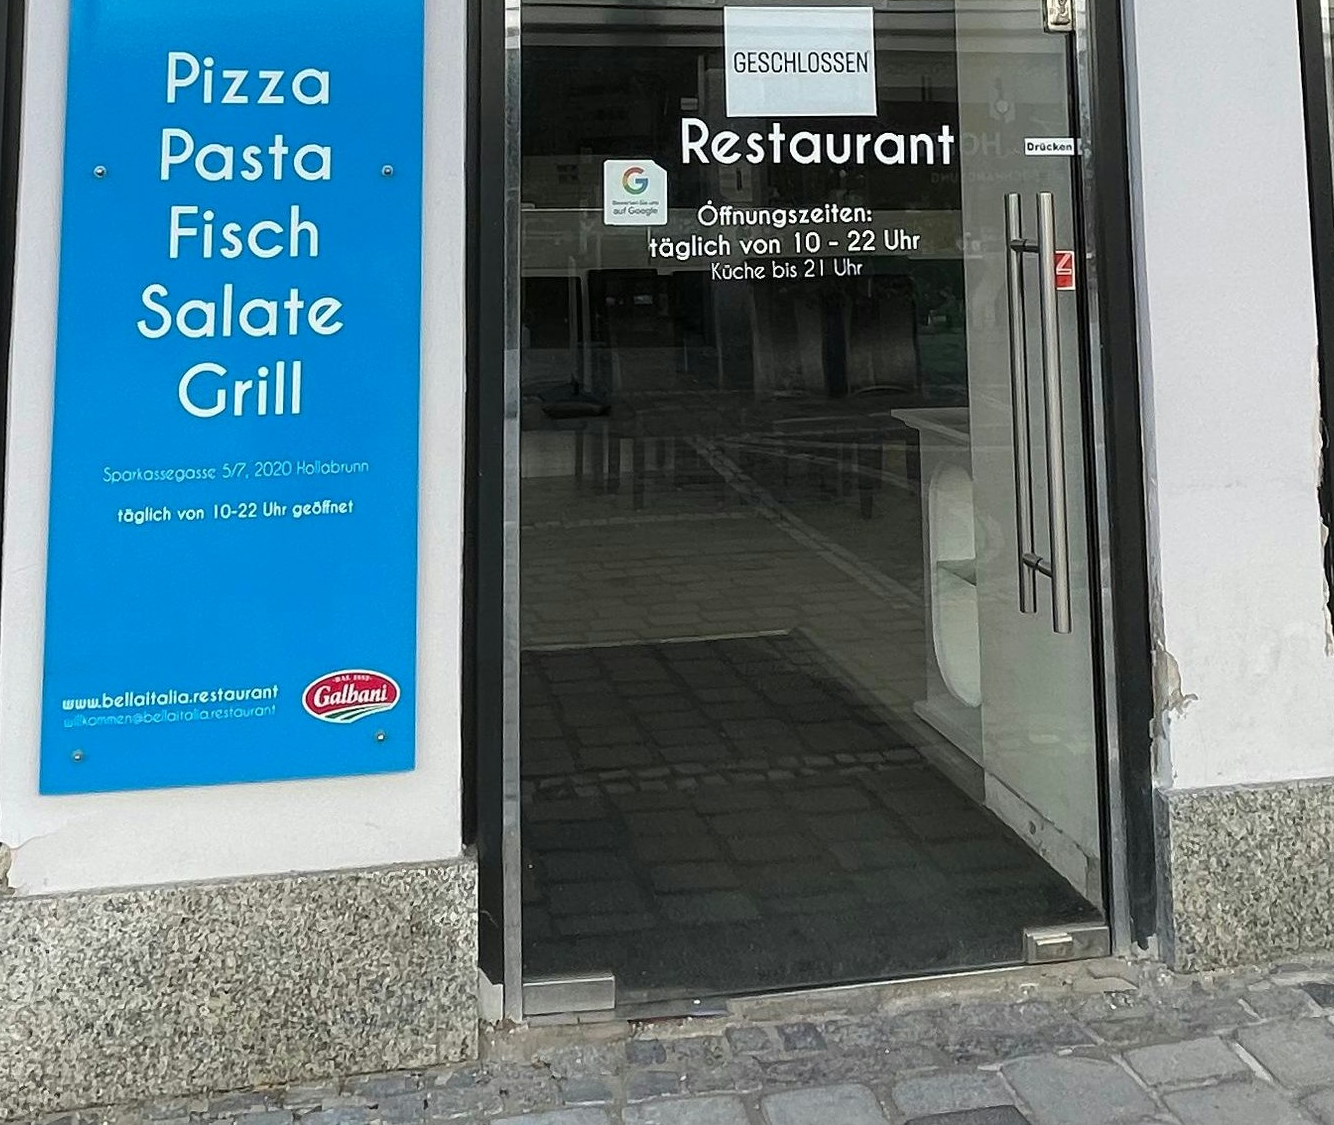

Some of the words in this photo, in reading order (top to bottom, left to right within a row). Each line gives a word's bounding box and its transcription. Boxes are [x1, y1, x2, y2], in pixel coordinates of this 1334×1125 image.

[166, 51, 330, 104] Pizza
[733, 50, 870, 75] GESCHLOSSEN
[160, 127, 332, 182] Pasta
[679, 118, 955, 166] Restaurant
[1025, 141, 1074, 153] Drücken
[169, 204, 319, 259] Fisch
[648, 235, 731, 263] täglich
[740, 238, 781, 255] von
[793, 231, 821, 254] 10
[847, 230, 877, 253] 22
[884, 229, 920, 251] Uhr
[711, 261, 766, 281] Küche
[772, 260, 798, 279] bis
[804, 259, 825, 279] 21
[833, 258, 863, 277] Uhr
[136, 283, 344, 339] Salate
[177, 360, 302, 417] Grill
[102, 465, 216, 485] Sparkassegasse
[254, 460, 292, 478] 2020
[296, 460, 370, 476] Hollabrunn
[117, 507, 172, 525] täglich
[177, 509, 205, 521] von
[213, 501, 258, 520] 10-22
[263, 501, 287, 518] Uhr
[292, 500, 354, 518] geöffnet
[61, 685, 279, 711] www.bellaitalia.restaurant
[313, 683, 388, 708] Galbani
